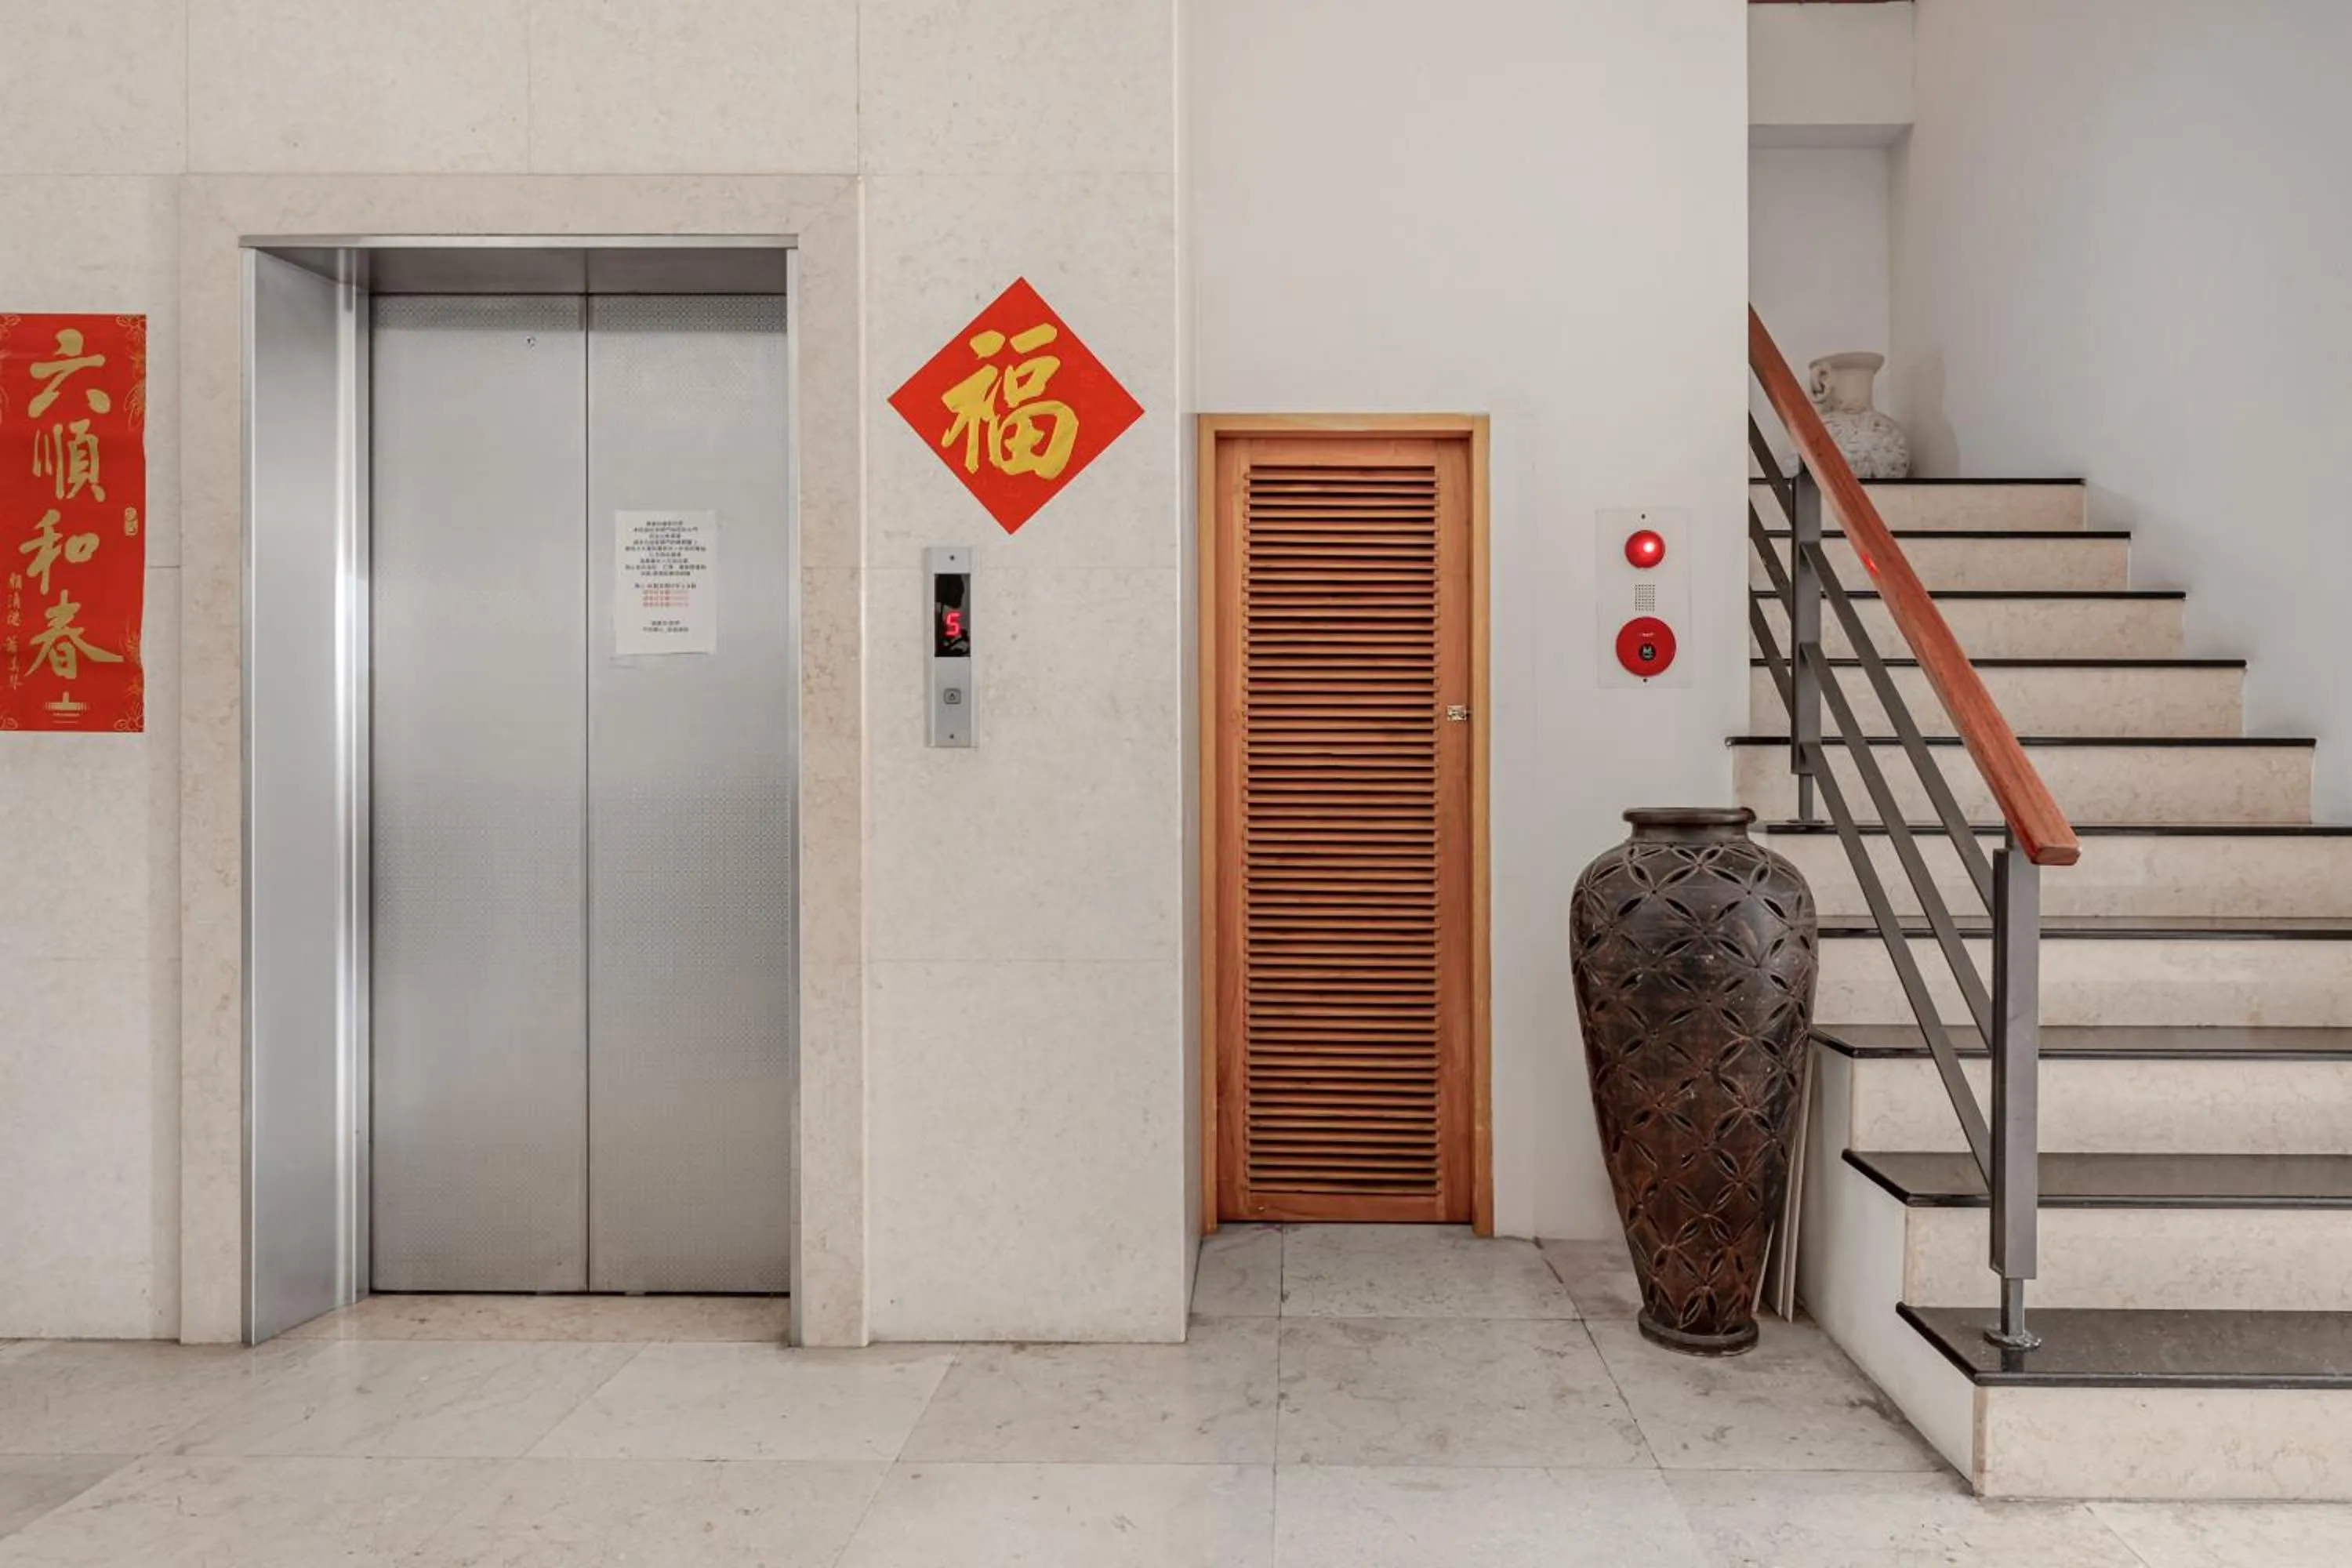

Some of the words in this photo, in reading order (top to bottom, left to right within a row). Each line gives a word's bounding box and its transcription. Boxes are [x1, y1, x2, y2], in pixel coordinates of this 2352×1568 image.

[941, 322, 1079, 480] 福
[19, 328, 124, 679] 六順和春
[945, 612, 961, 637] 5
